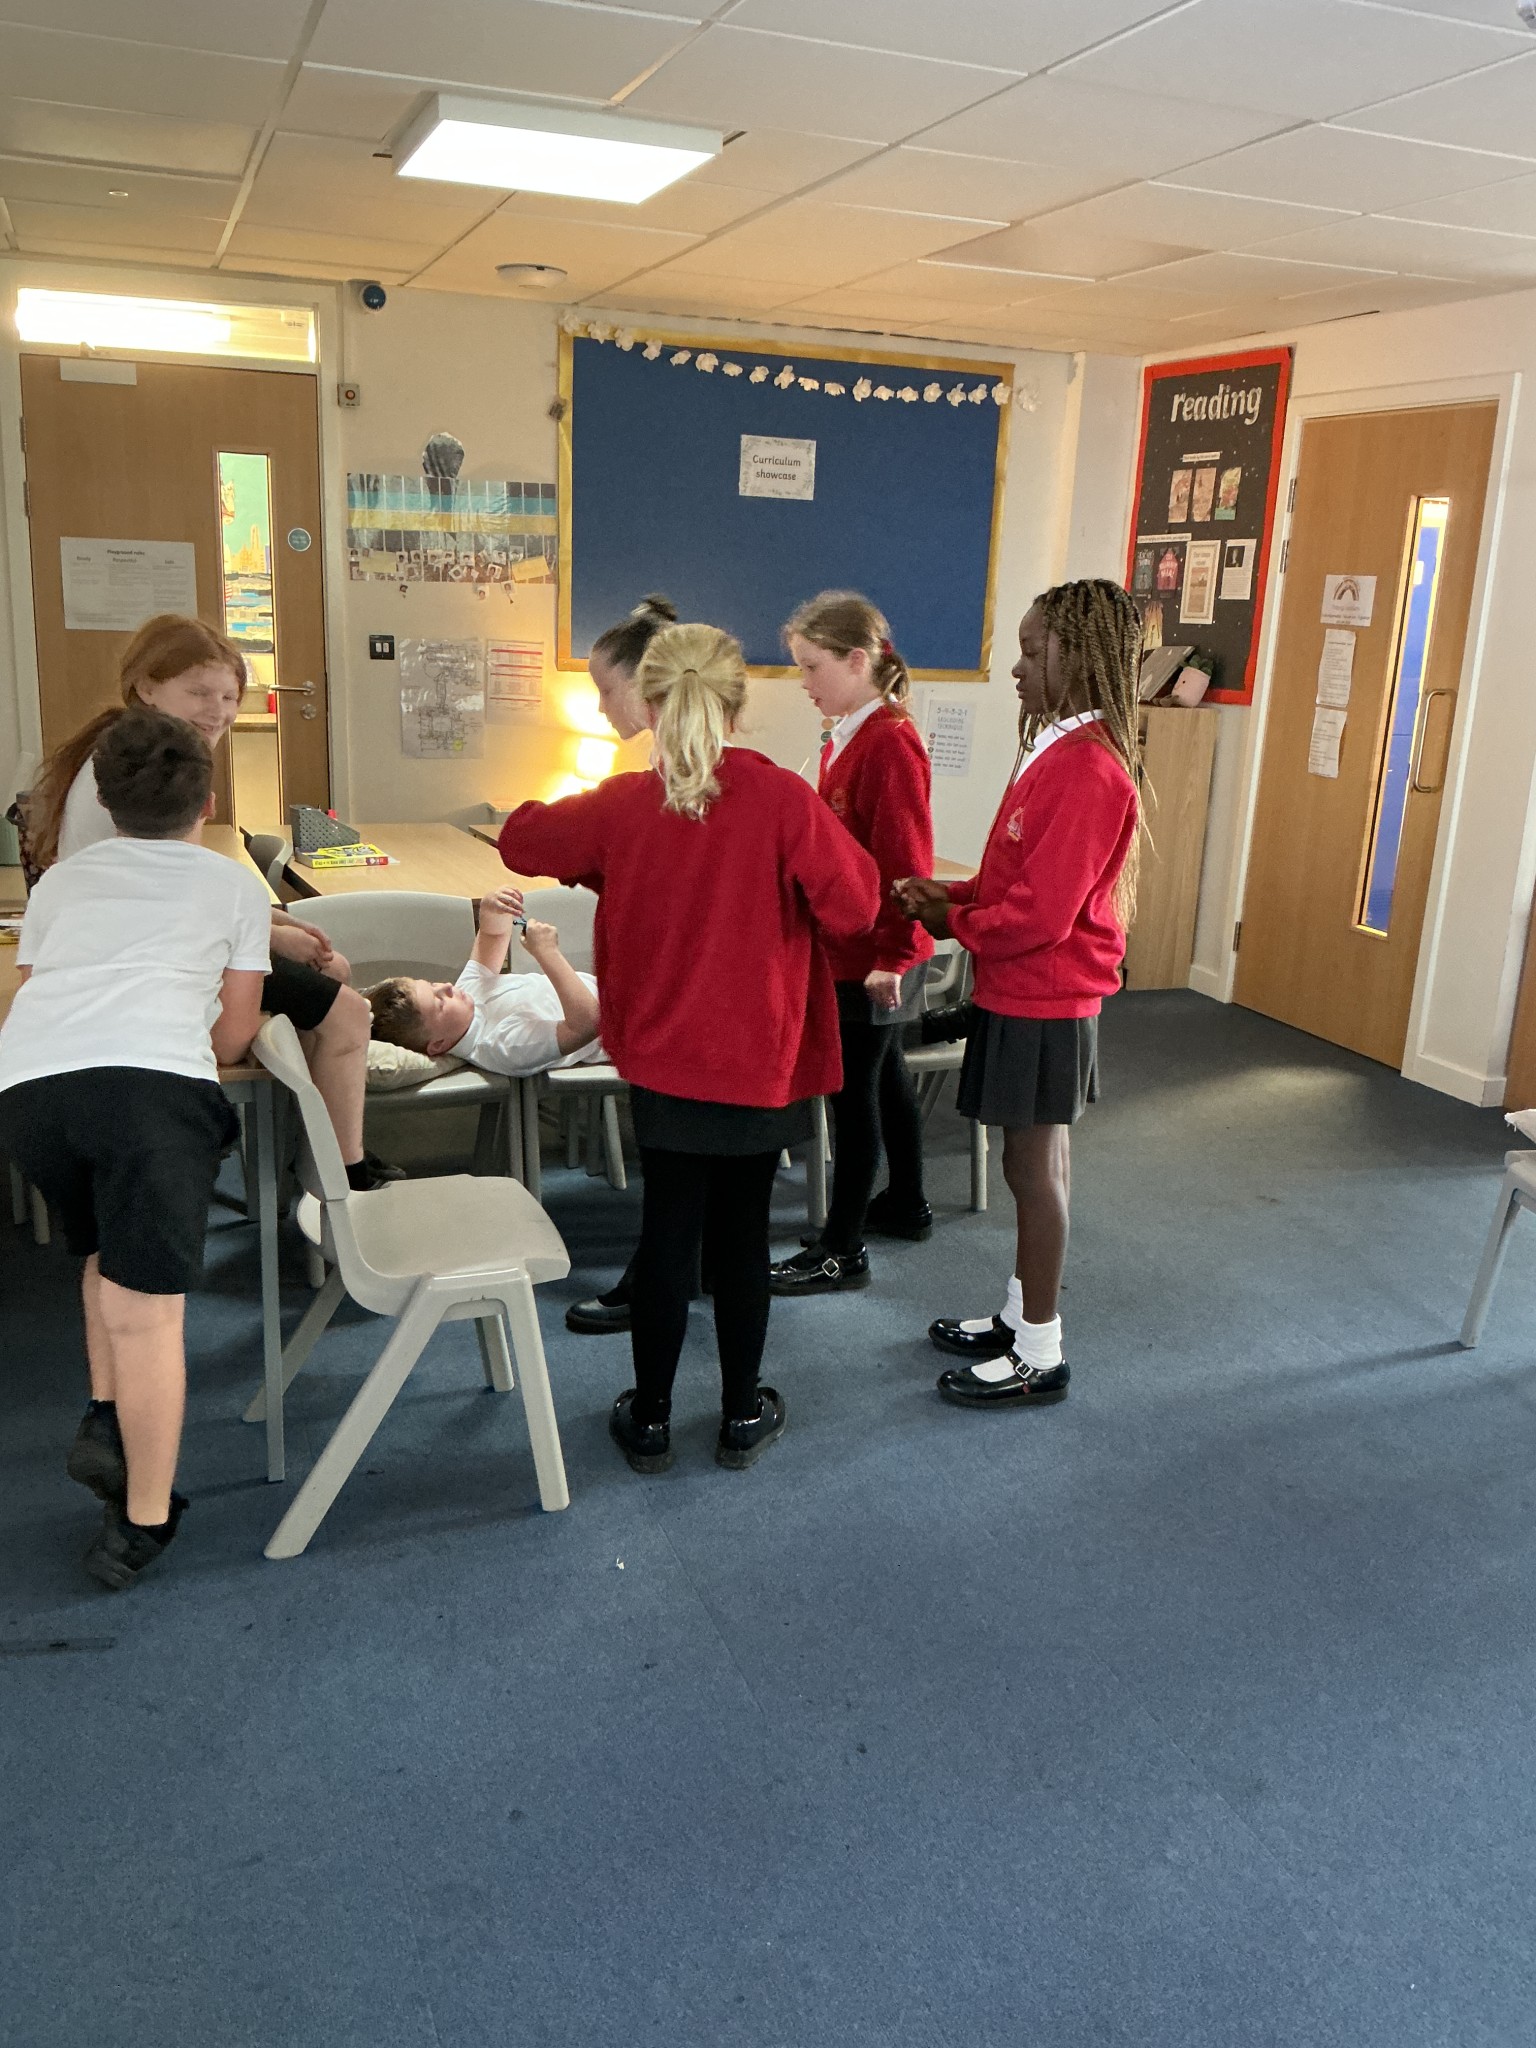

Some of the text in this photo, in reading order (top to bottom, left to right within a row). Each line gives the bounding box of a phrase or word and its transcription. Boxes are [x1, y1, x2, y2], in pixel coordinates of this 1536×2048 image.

[1170, 383, 1263, 426] reading
[752, 454, 801, 467] Curriculum
[755, 469, 797, 481] showcase
